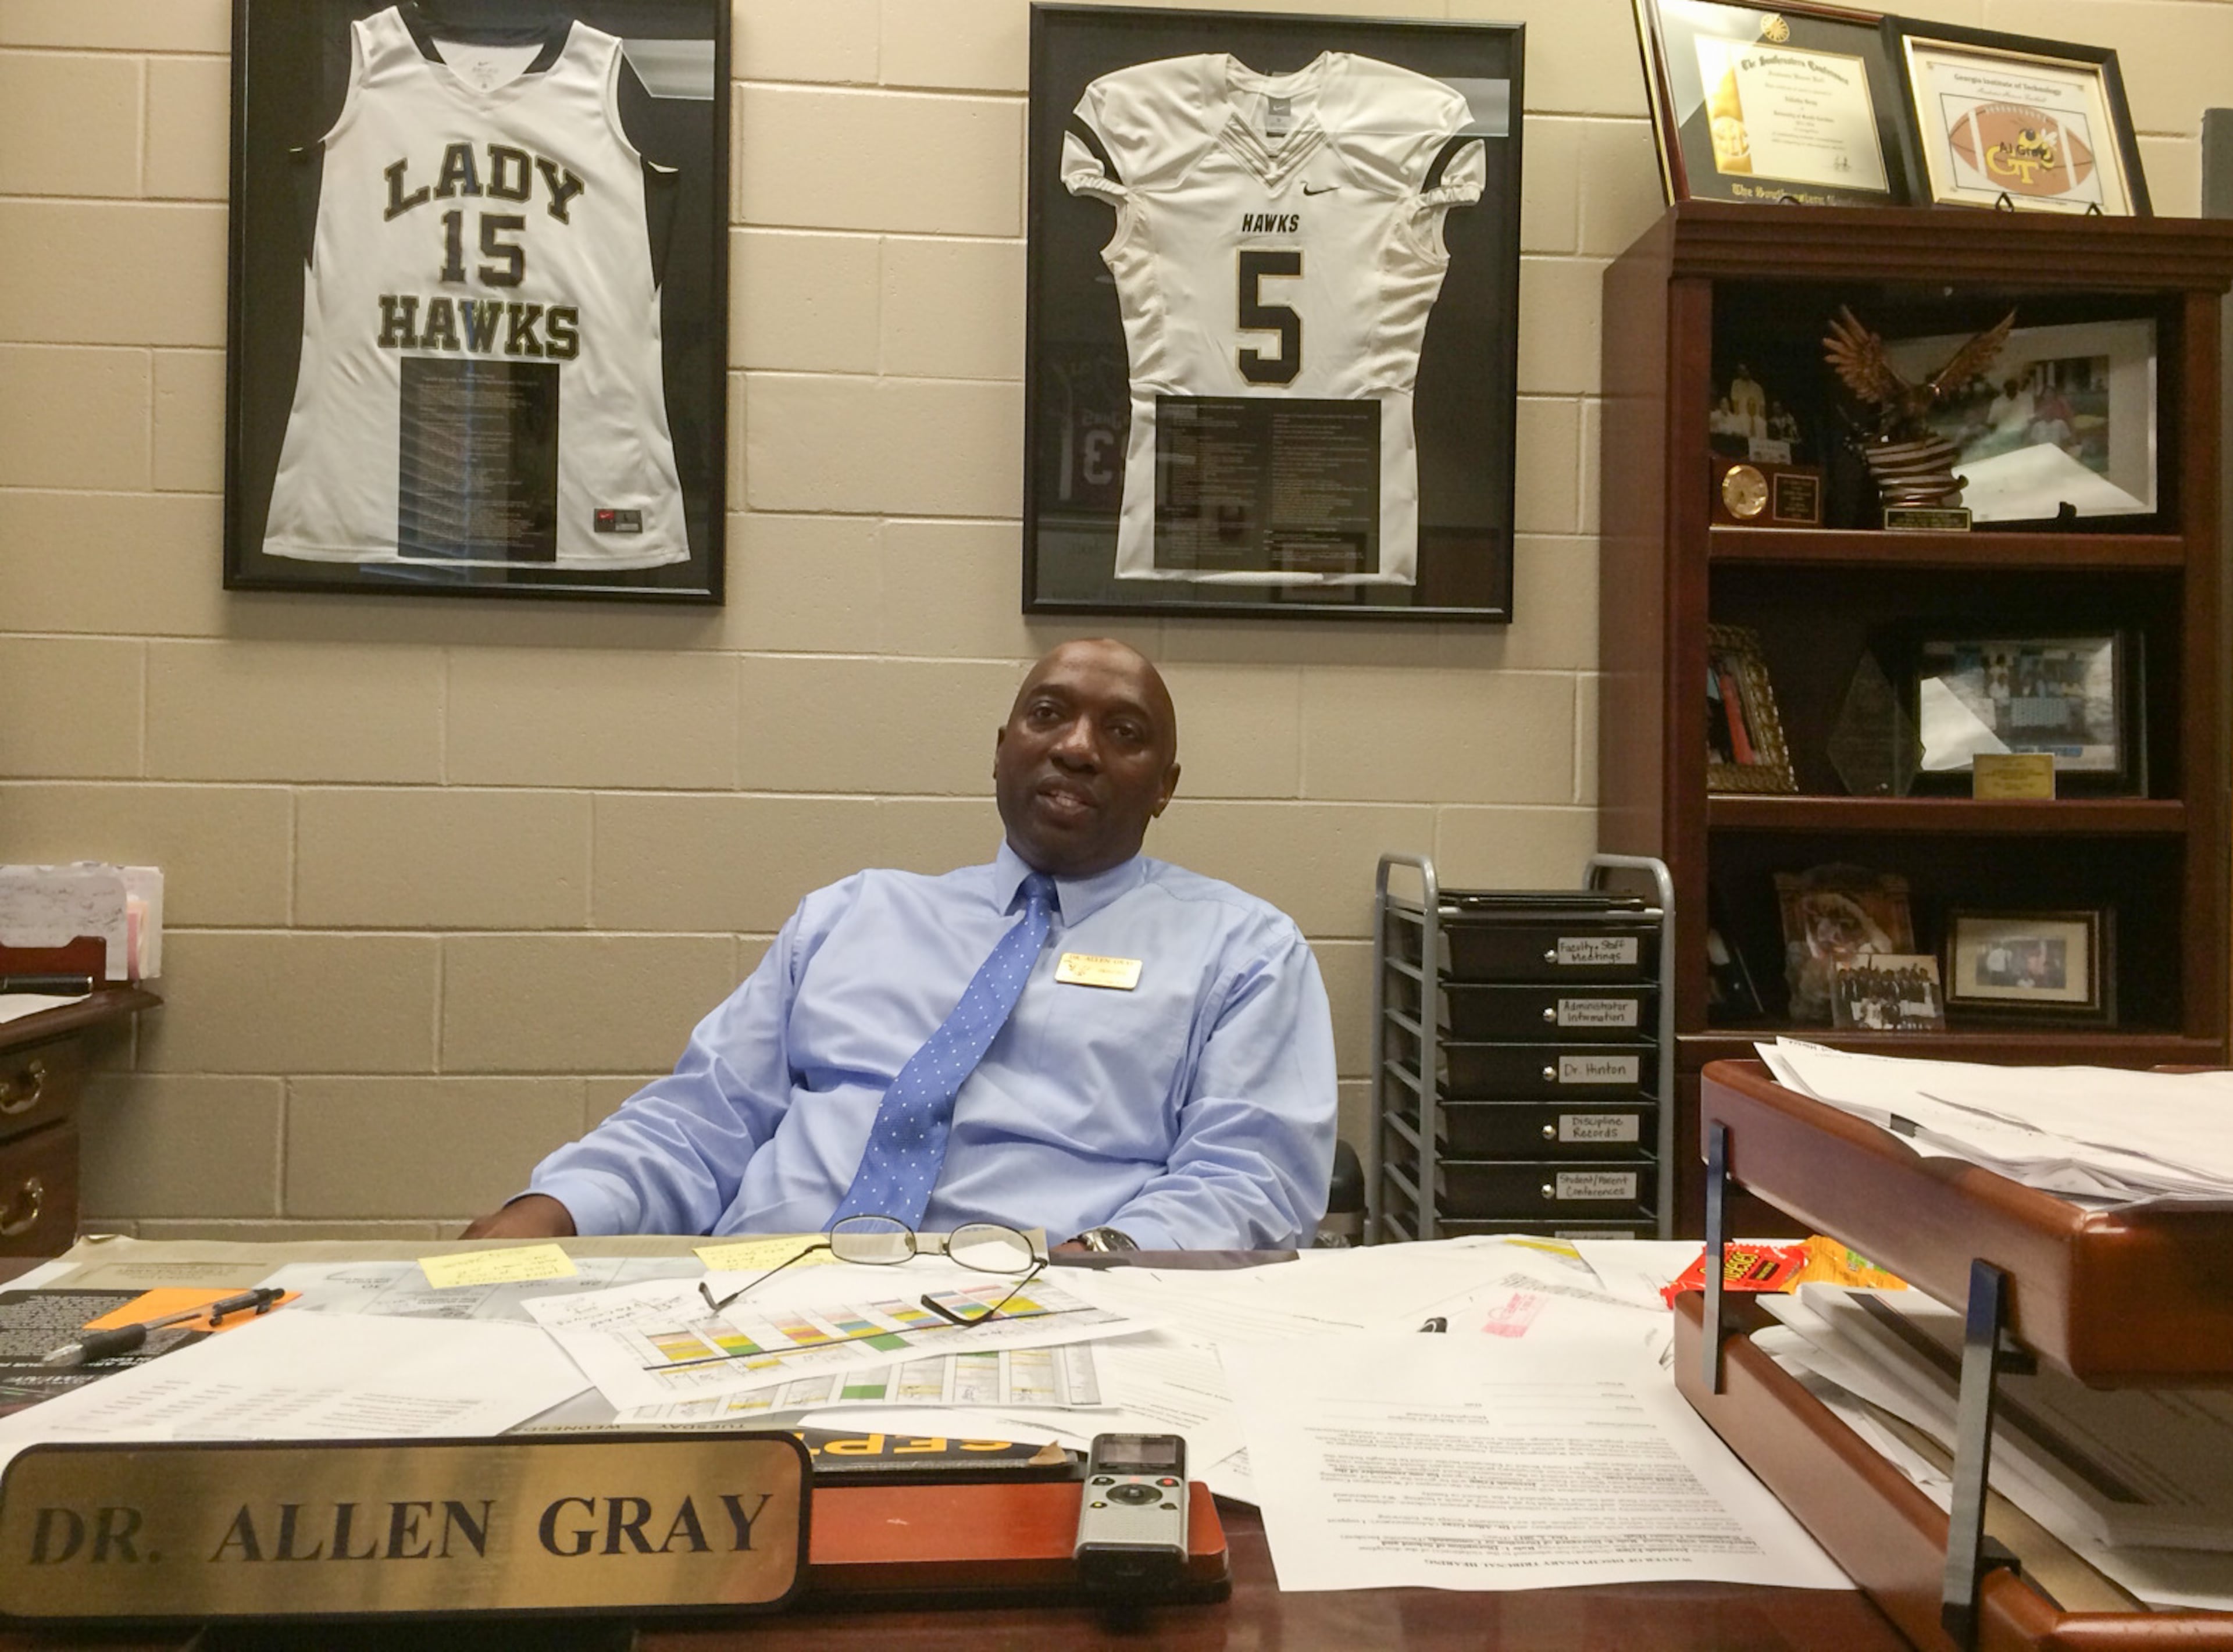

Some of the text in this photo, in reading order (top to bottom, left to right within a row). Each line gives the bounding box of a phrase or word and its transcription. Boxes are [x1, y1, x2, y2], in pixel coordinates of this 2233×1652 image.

[384, 142, 584, 226] LADY
[1242, 213, 1300, 234] HAWKS
[440, 209, 526, 289] 15
[1235, 245, 1305, 387] 5
[378, 294, 580, 361] HAWKS
[1601, 940, 1626, 950] Staff
[1572, 951, 1621, 964] Meetings
[1564, 1001, 1628, 1011] Administrator
[1568, 1012, 1624, 1022] Information
[1572, 1116, 1624, 1128] Discipline
[1572, 1128, 1618, 1138] Records
[1567, 1186, 1625, 1197] Conferences
[28, 1493, 773, 1565] DR. ALLEN GRAY
